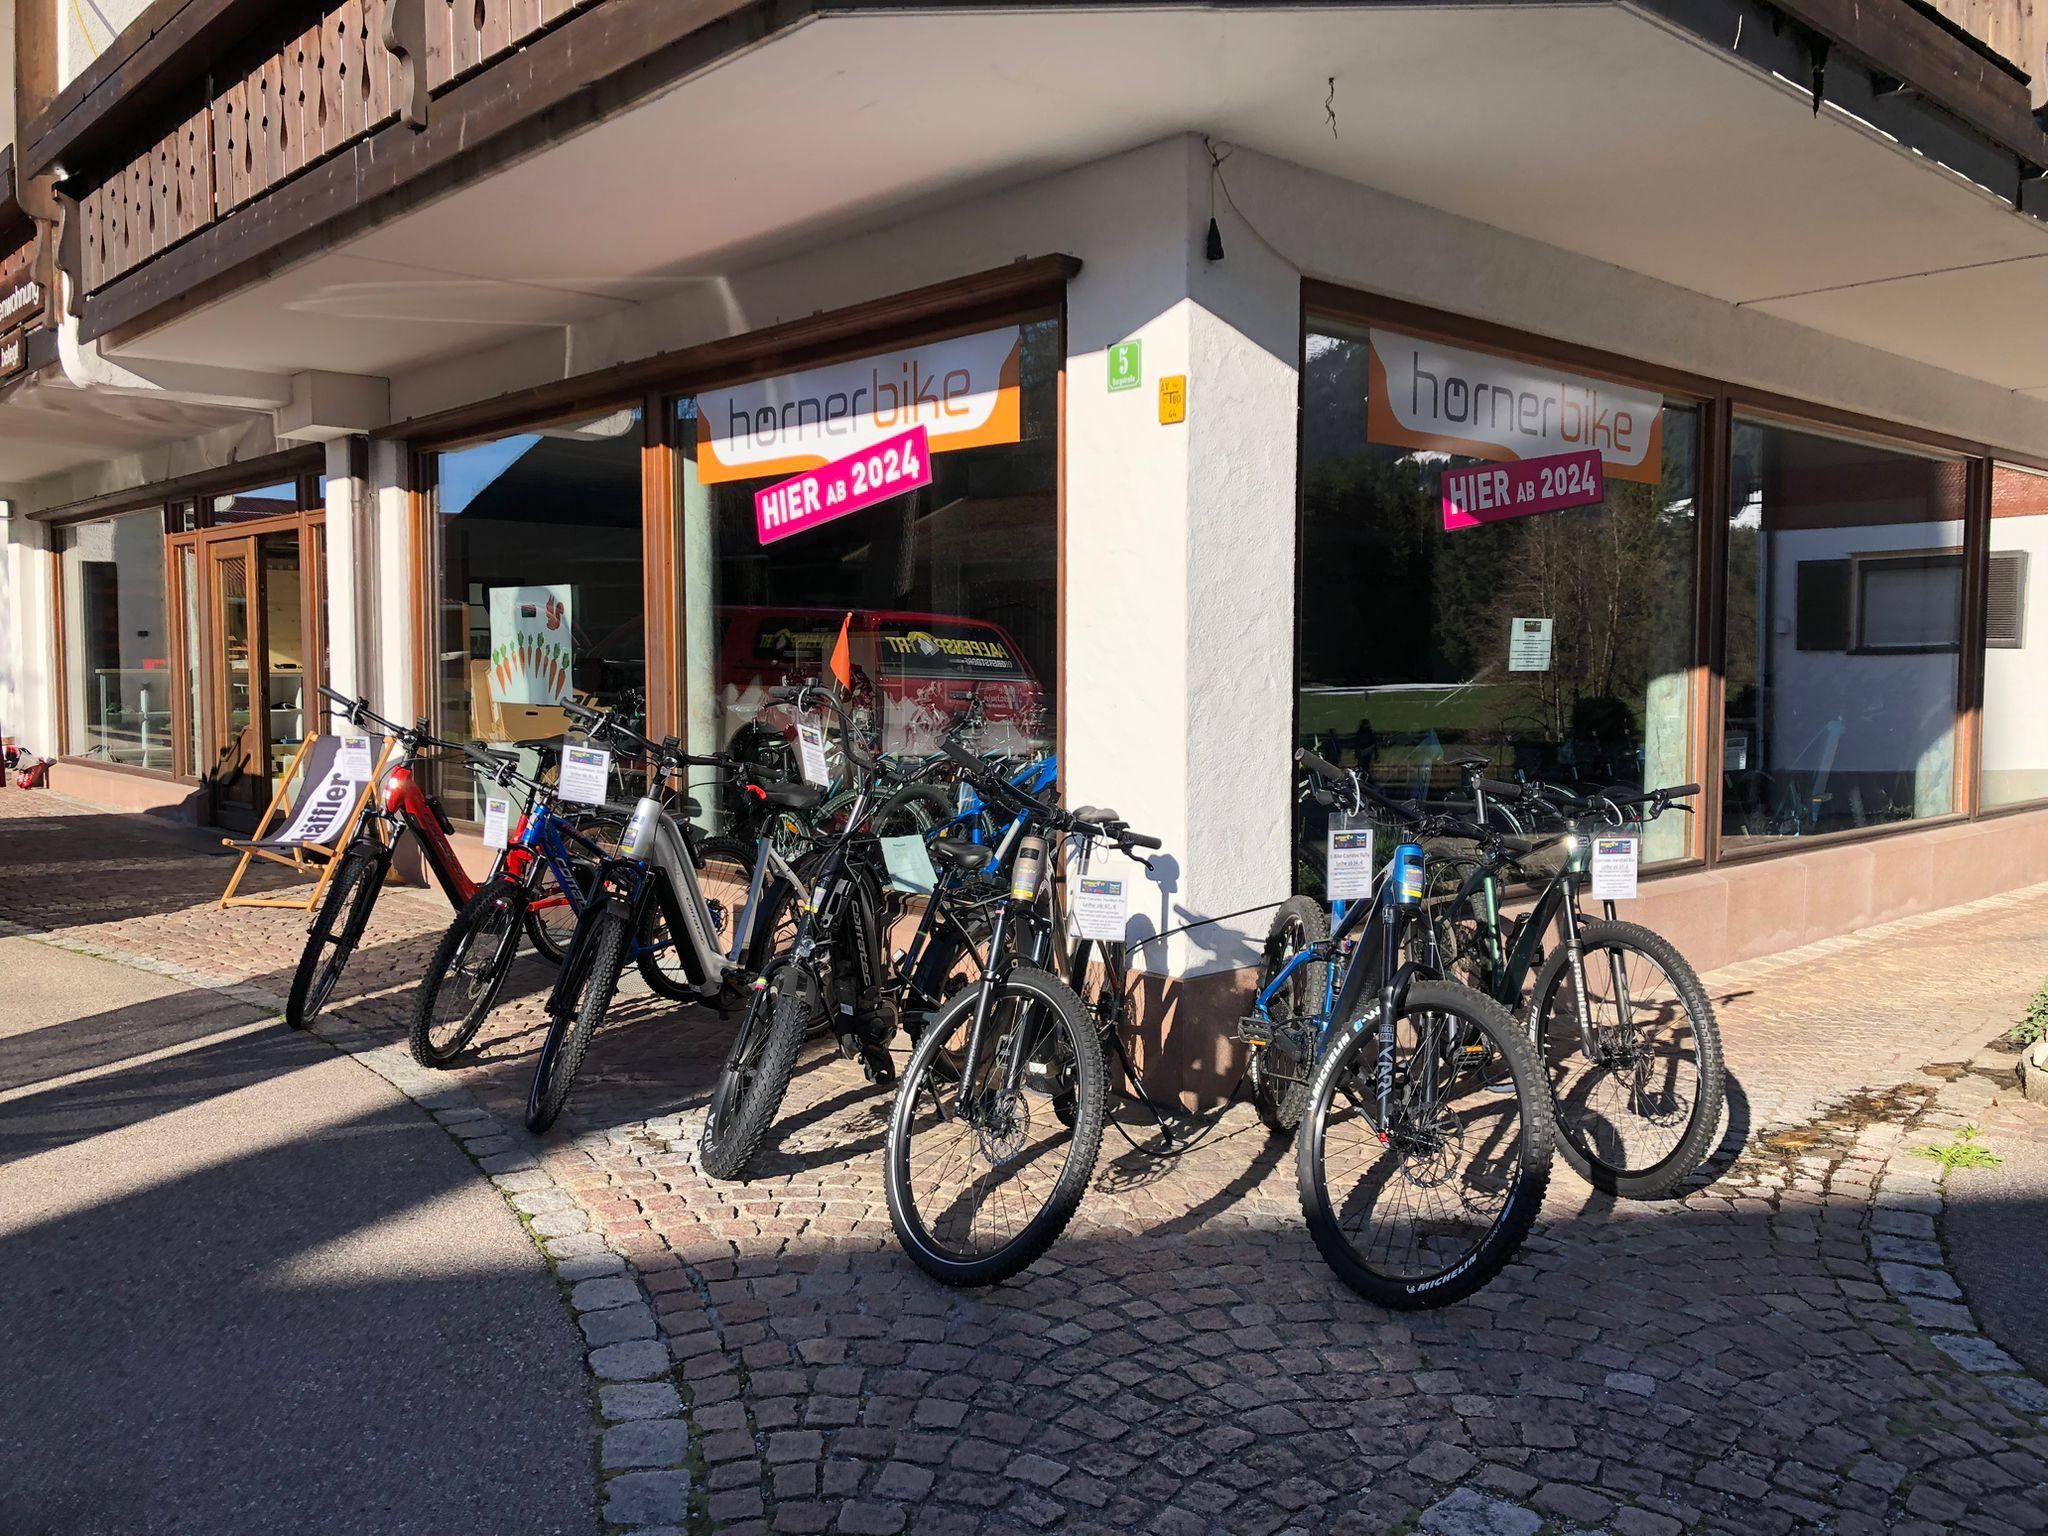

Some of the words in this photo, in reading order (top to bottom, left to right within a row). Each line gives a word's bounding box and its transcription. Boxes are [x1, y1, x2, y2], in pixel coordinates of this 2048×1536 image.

[0, 281, 39, 320] enwohnung
[1118, 347, 1129, 375] 5
[762, 477, 821, 530] HIER
[826, 479, 847, 506] AB
[852, 439, 920, 497] 2024
[1449, 470, 1510, 515] HIER
[1516, 480, 1535, 503] AB
[1540, 460, 1596, 499] 2024
[291, 772, 351, 843] häffler
[851, 899, 873, 987] corratec
[1573, 962, 1589, 1028] manitou
[1311, 1032, 1351, 1101] MICHELIN
[1377, 1045, 1394, 1101] YARI
[1418, 1252, 1478, 1292] MICHELIN
